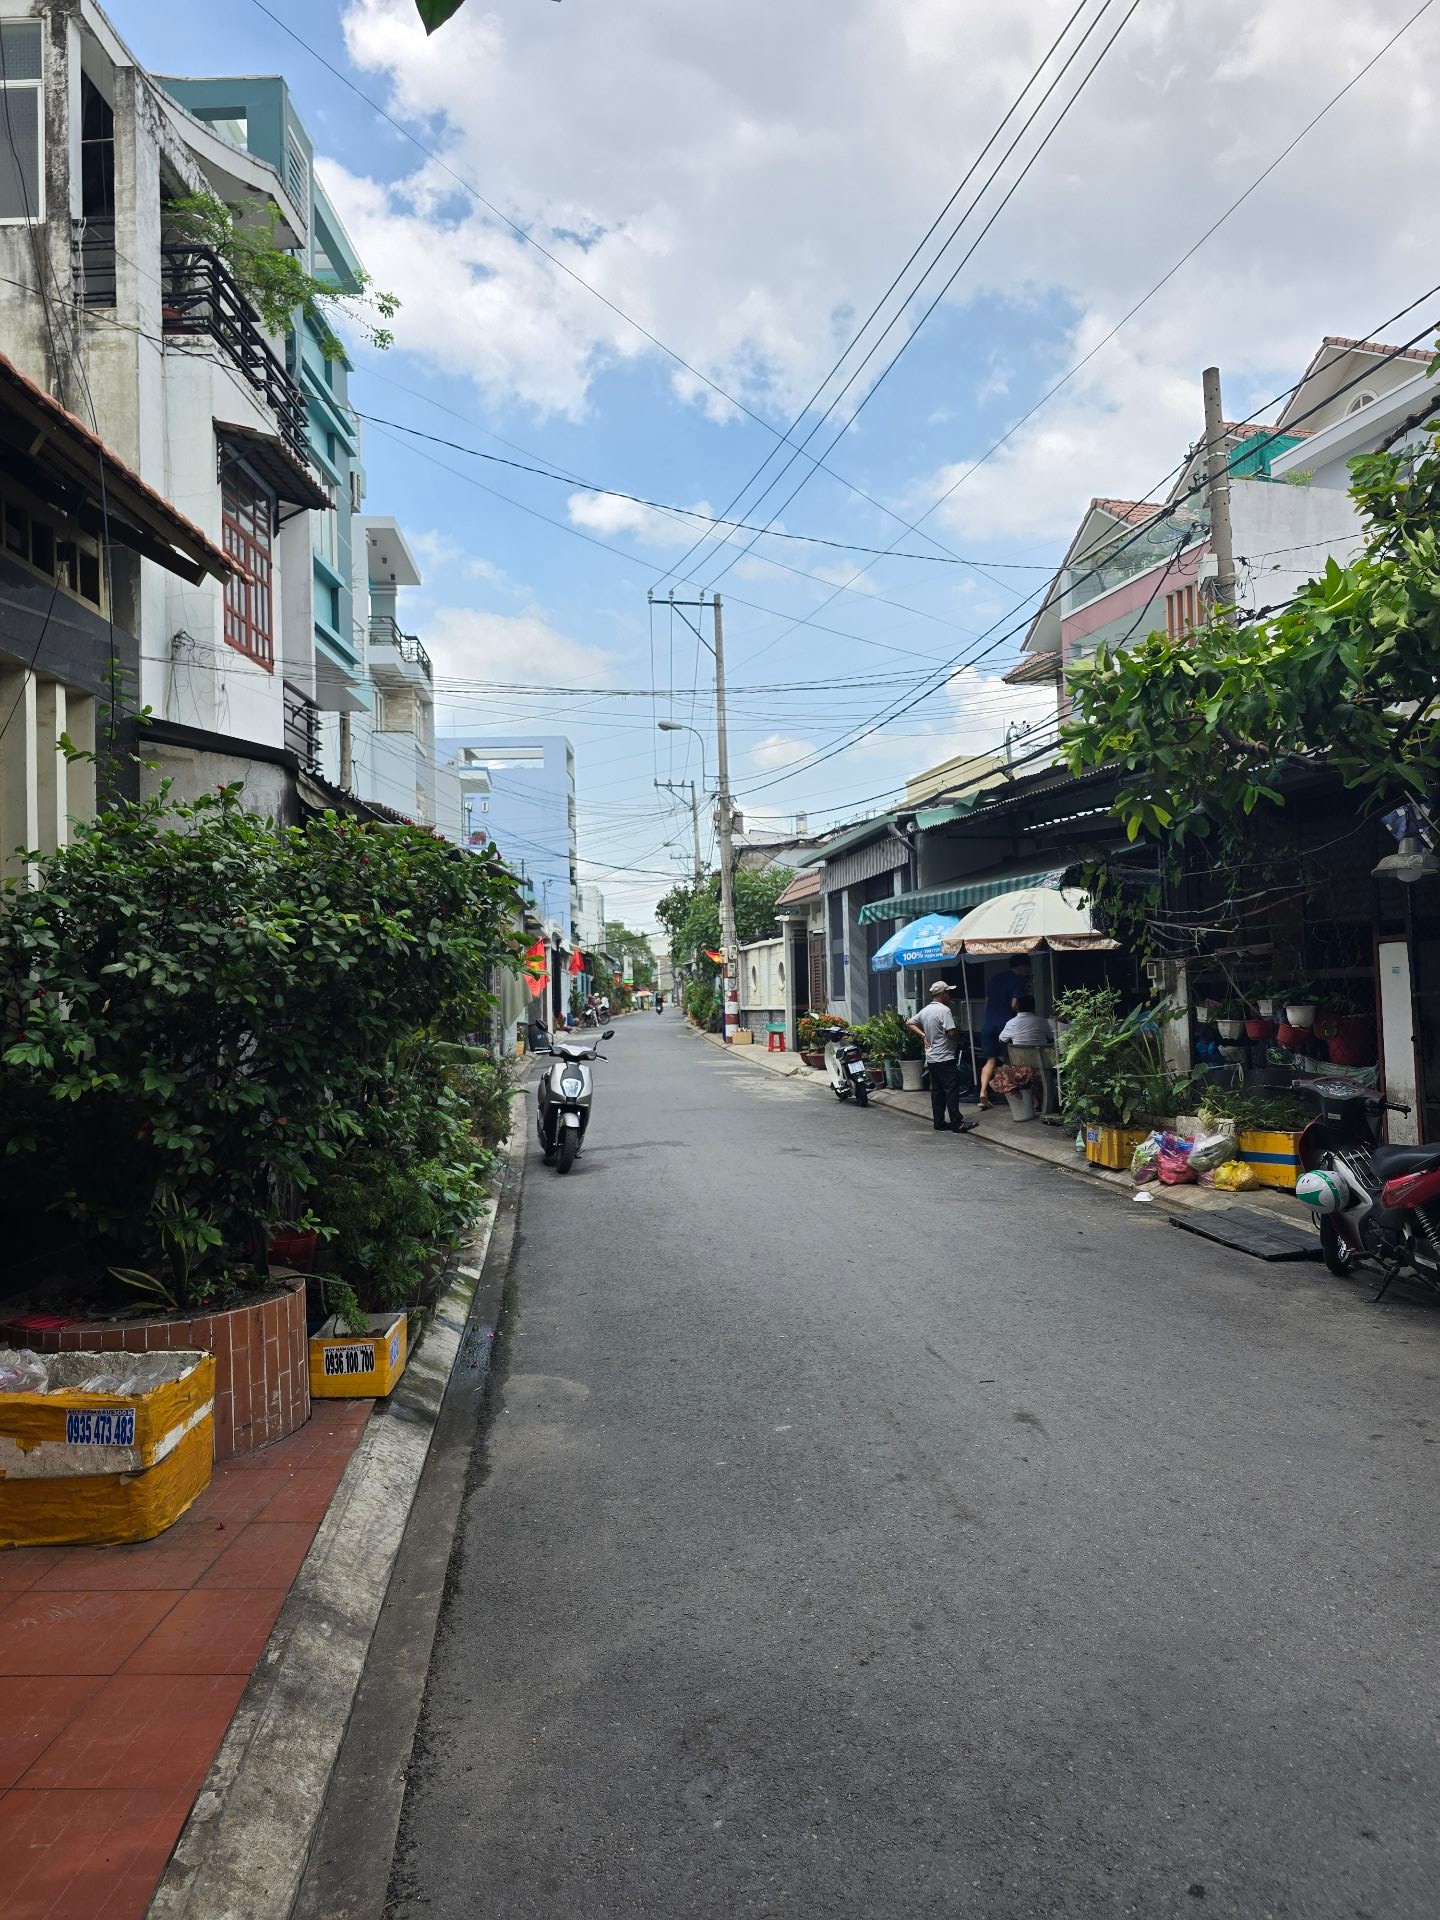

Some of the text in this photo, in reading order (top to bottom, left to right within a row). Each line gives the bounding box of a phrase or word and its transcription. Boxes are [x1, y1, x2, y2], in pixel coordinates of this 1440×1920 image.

[903, 951, 924, 961] 100%
[325, 1350, 375, 1375] 0936.100.700
[67, 1415, 134, 1445] 0935.473.483
